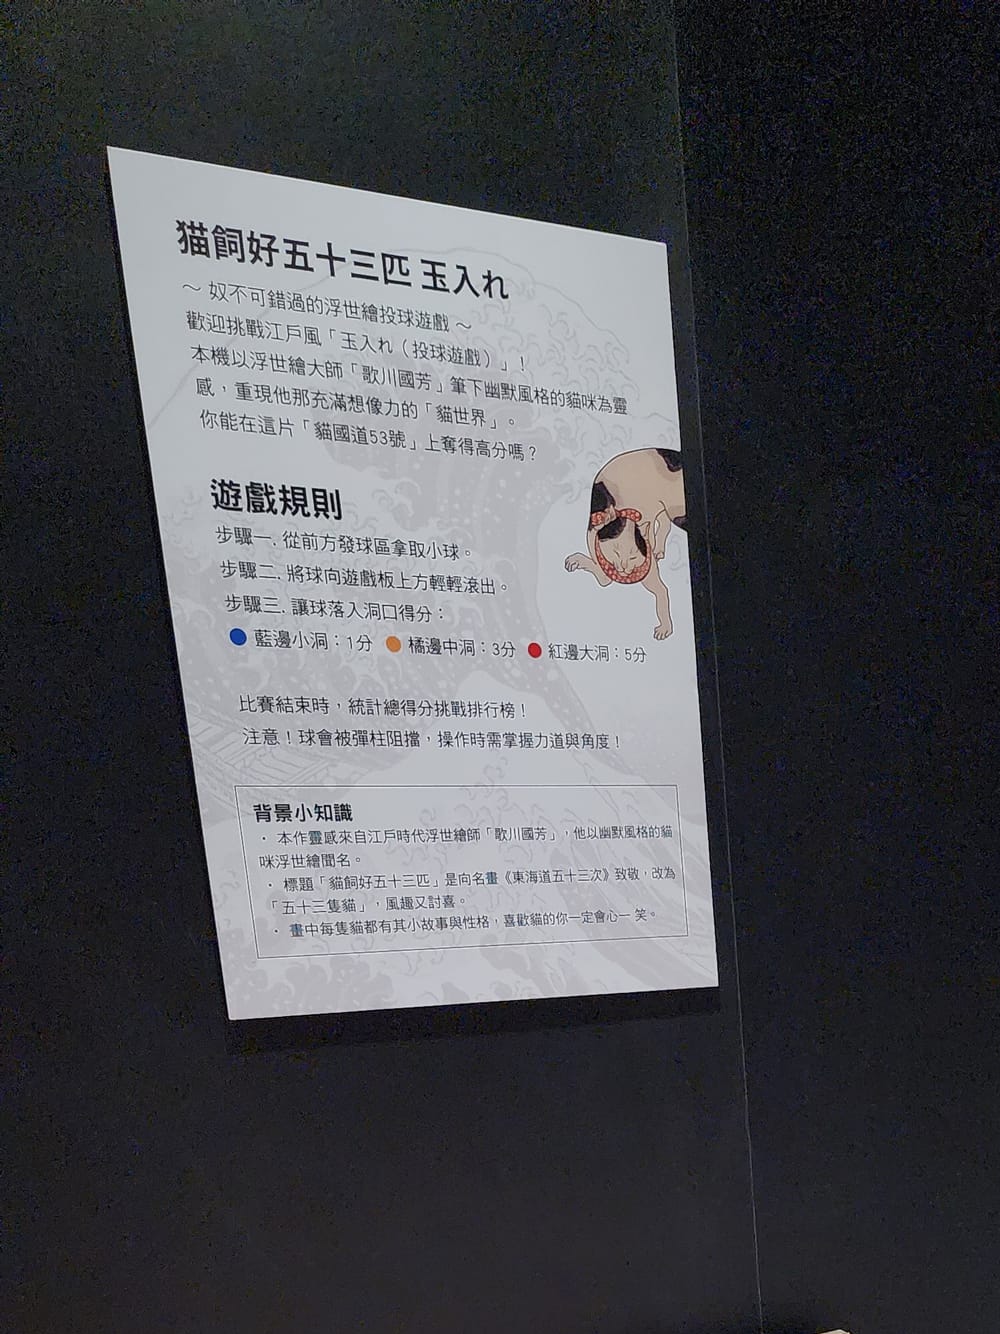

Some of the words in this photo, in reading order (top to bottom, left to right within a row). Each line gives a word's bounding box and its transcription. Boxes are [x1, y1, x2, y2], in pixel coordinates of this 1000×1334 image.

[176, 219, 413, 287] 猫飼好五十三匹
[420, 258, 509, 300] 玉入れ
[209, 281, 450, 332] 奴不可錯過的浮世繪投球遊戲
[210, 478, 343, 521] 遊戲規則
[252, 802, 354, 824] 背景小知識
